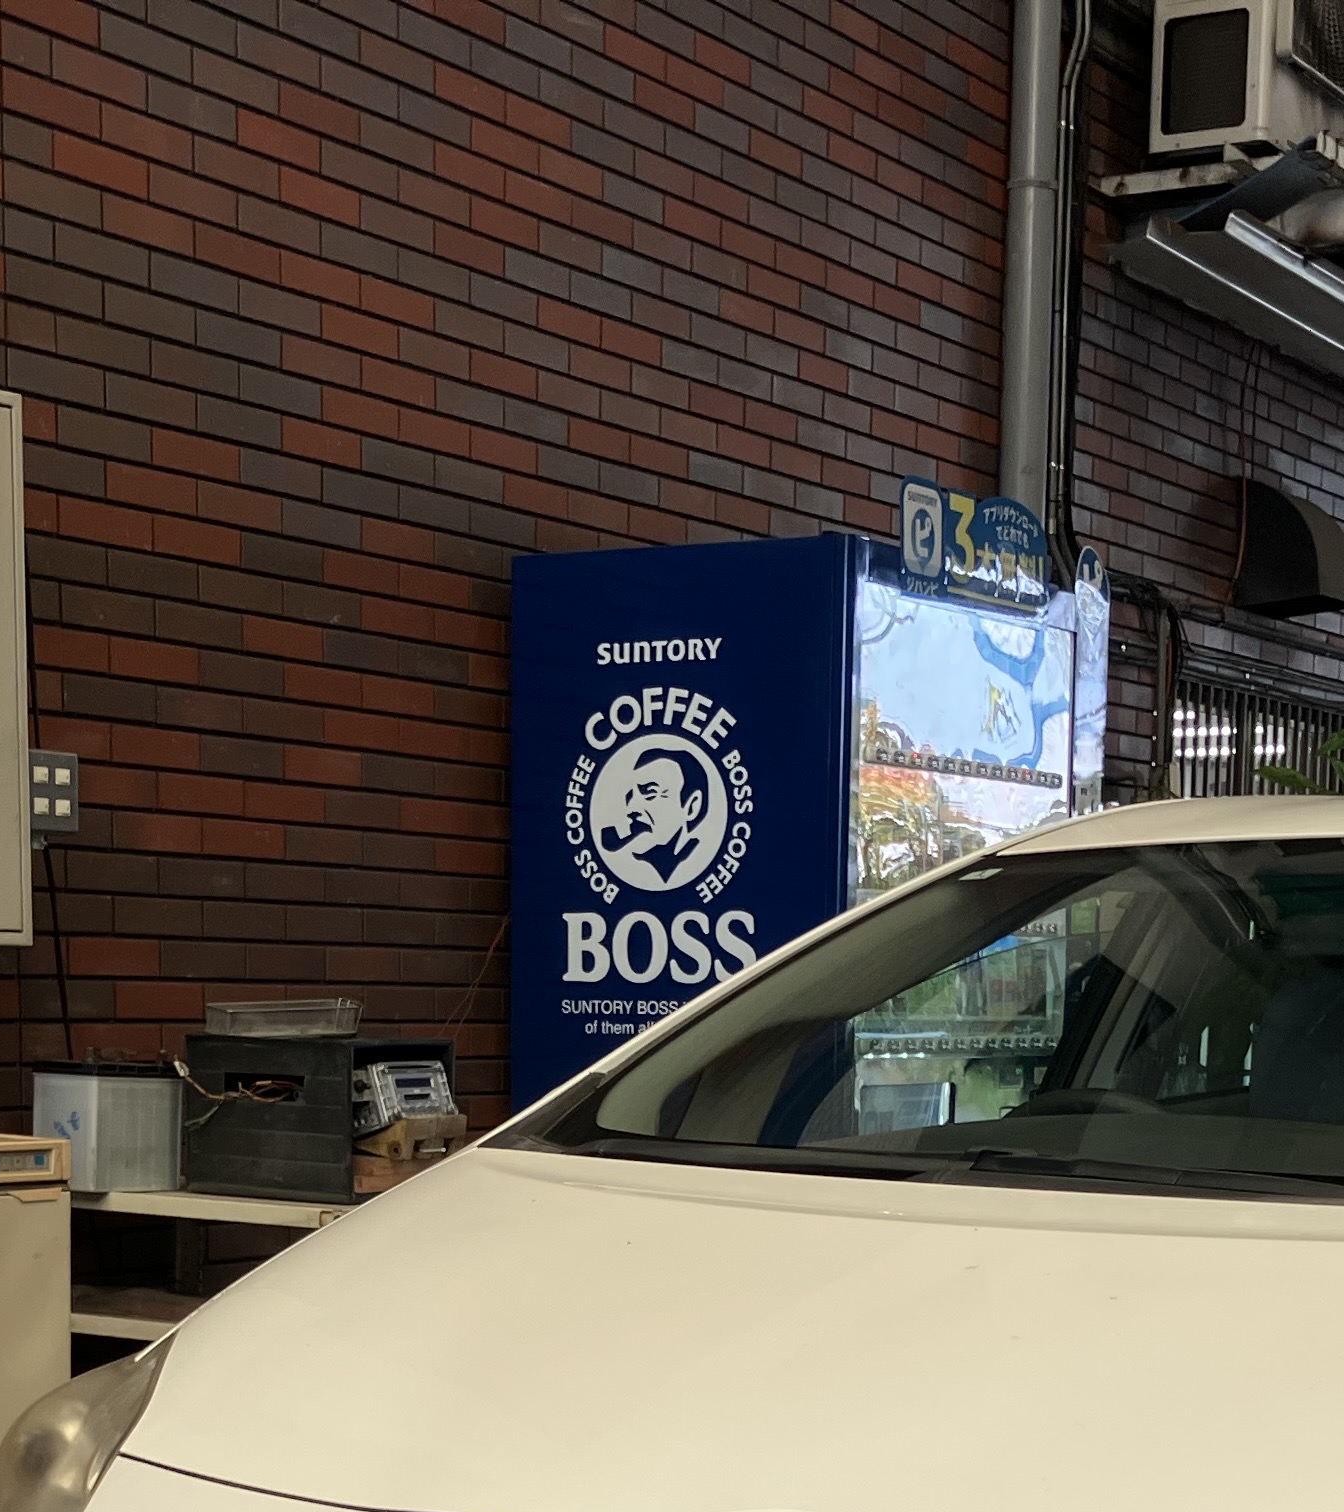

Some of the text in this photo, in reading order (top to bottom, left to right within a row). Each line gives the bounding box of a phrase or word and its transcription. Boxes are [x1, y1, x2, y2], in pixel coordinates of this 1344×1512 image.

[597, 637, 723, 666] SUNTORY
[584, 687, 738, 751] COFFEE
[565, 754, 620, 905] BOSS COFFEE
[694, 749, 754, 904] BOSS COFFEE
[562, 910, 757, 984] BOSS
[561, 1000, 679, 1015] SUNTORY BOSS
[584, 1020, 598, 1035] of
[600, 1020, 635, 1035] them
